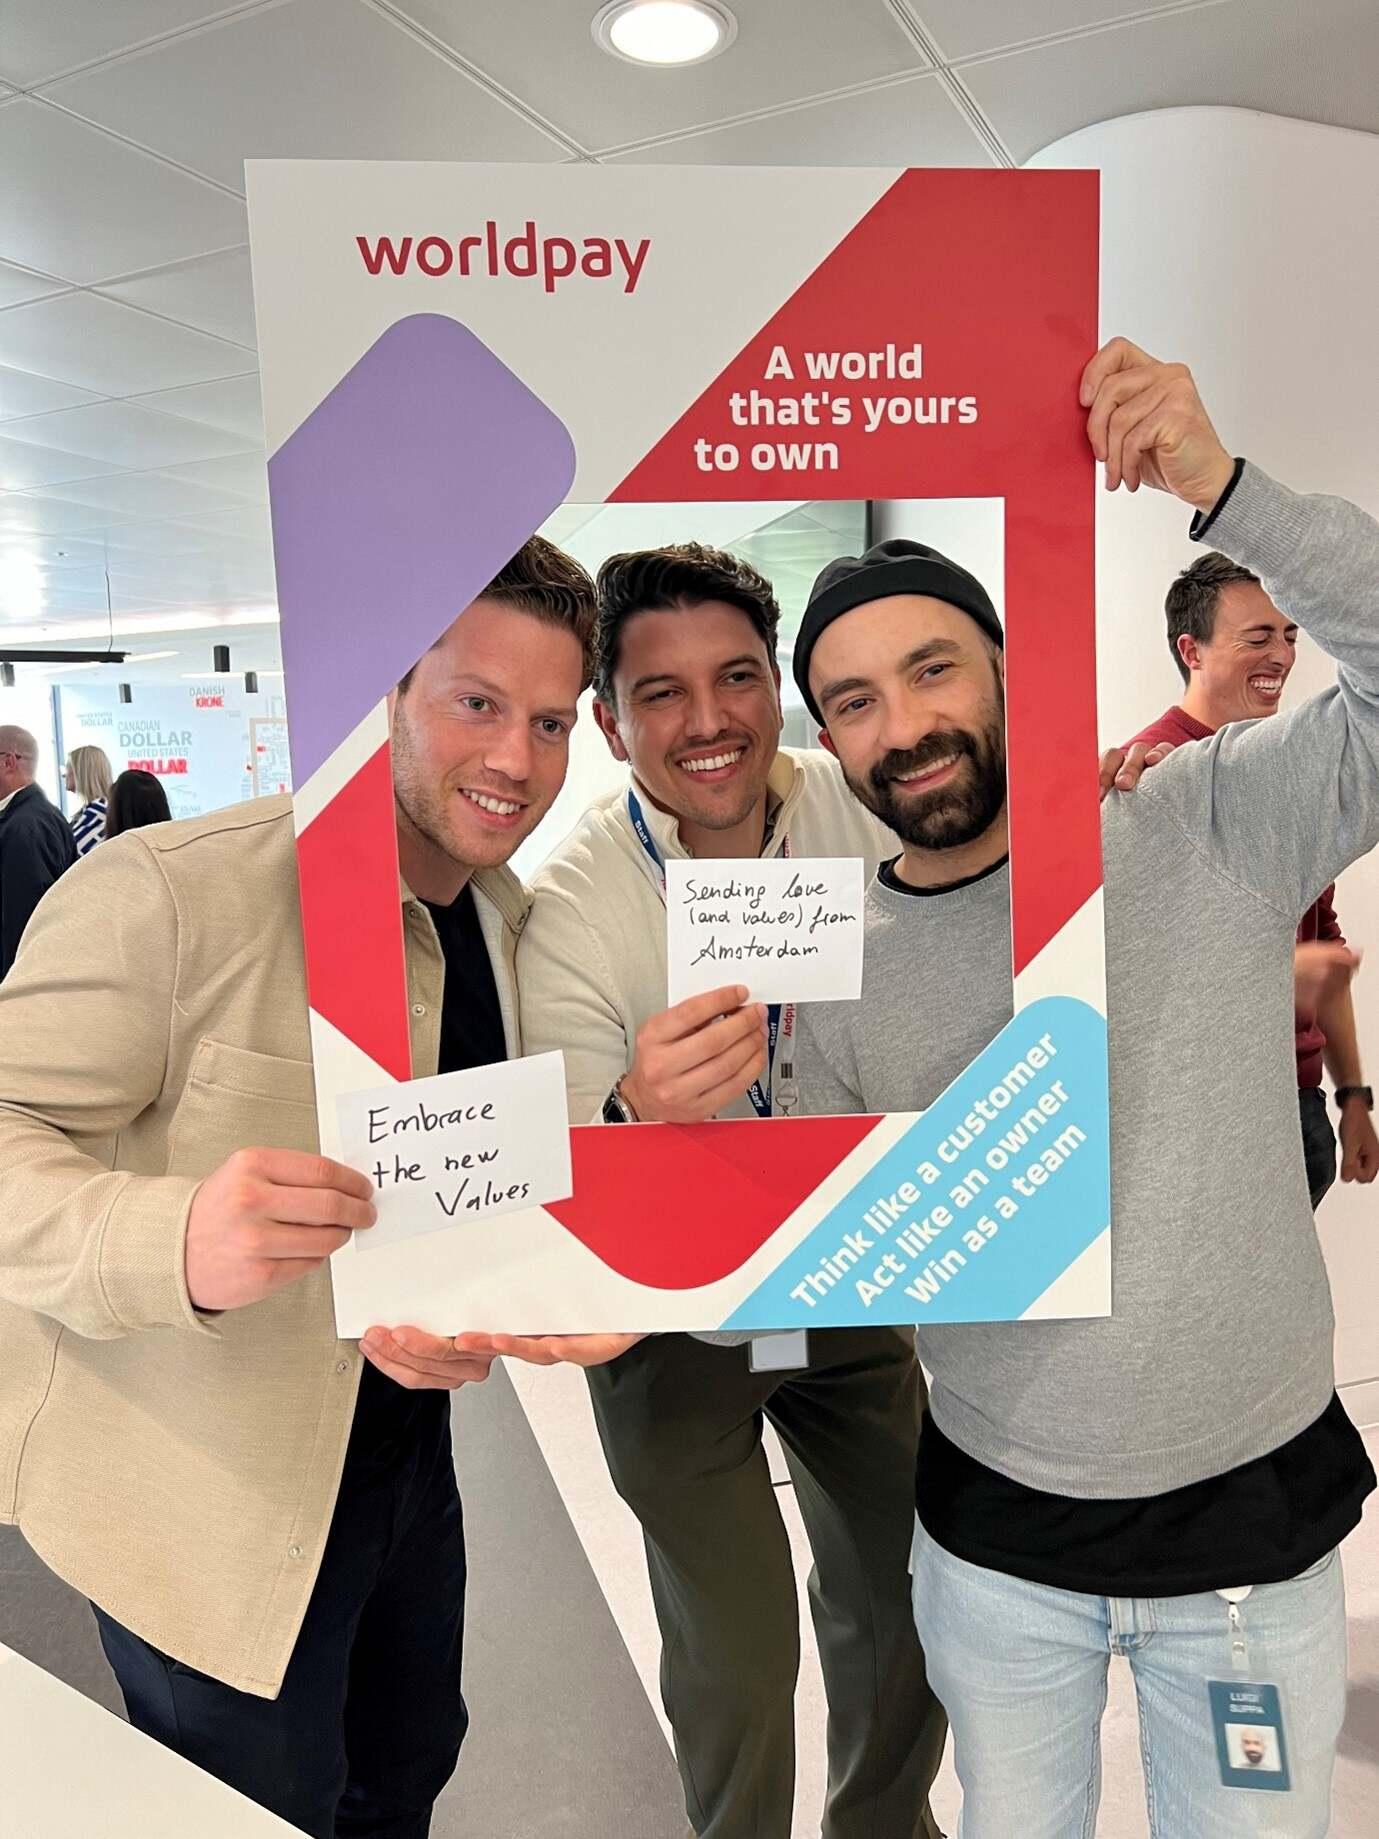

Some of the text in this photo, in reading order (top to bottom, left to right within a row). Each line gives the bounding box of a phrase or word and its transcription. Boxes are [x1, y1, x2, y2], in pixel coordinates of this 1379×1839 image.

[356, 221, 651, 293] worldpay
[764, 343, 922, 380] A world
[729, 389, 978, 432] that's yours
[693, 438, 839, 471] to own
[189, 685, 225, 697] DANISH
[118, 719, 160, 731] CANADIAN
[120, 731, 192, 747] DOLLAR
[159, 747, 188, 757] STATES
[634, 820, 649, 844] Staff
[683, 879, 766, 909] Sending
[782, 873, 828, 900] love
[690, 903, 857, 934] (and values) from
[690, 936, 819, 966] Amsterdam
[749, 1085, 765, 1108] Staff
[368, 1103, 496, 1144] Embrace
[372, 1149, 499, 1189] the new
[789, 1033, 1058, 1307] Think like a customer
[435, 1178, 530, 1216] Values
[854, 1079, 1070, 1307] Act like an owner
[904, 1124, 1087, 1304] Win as a team
